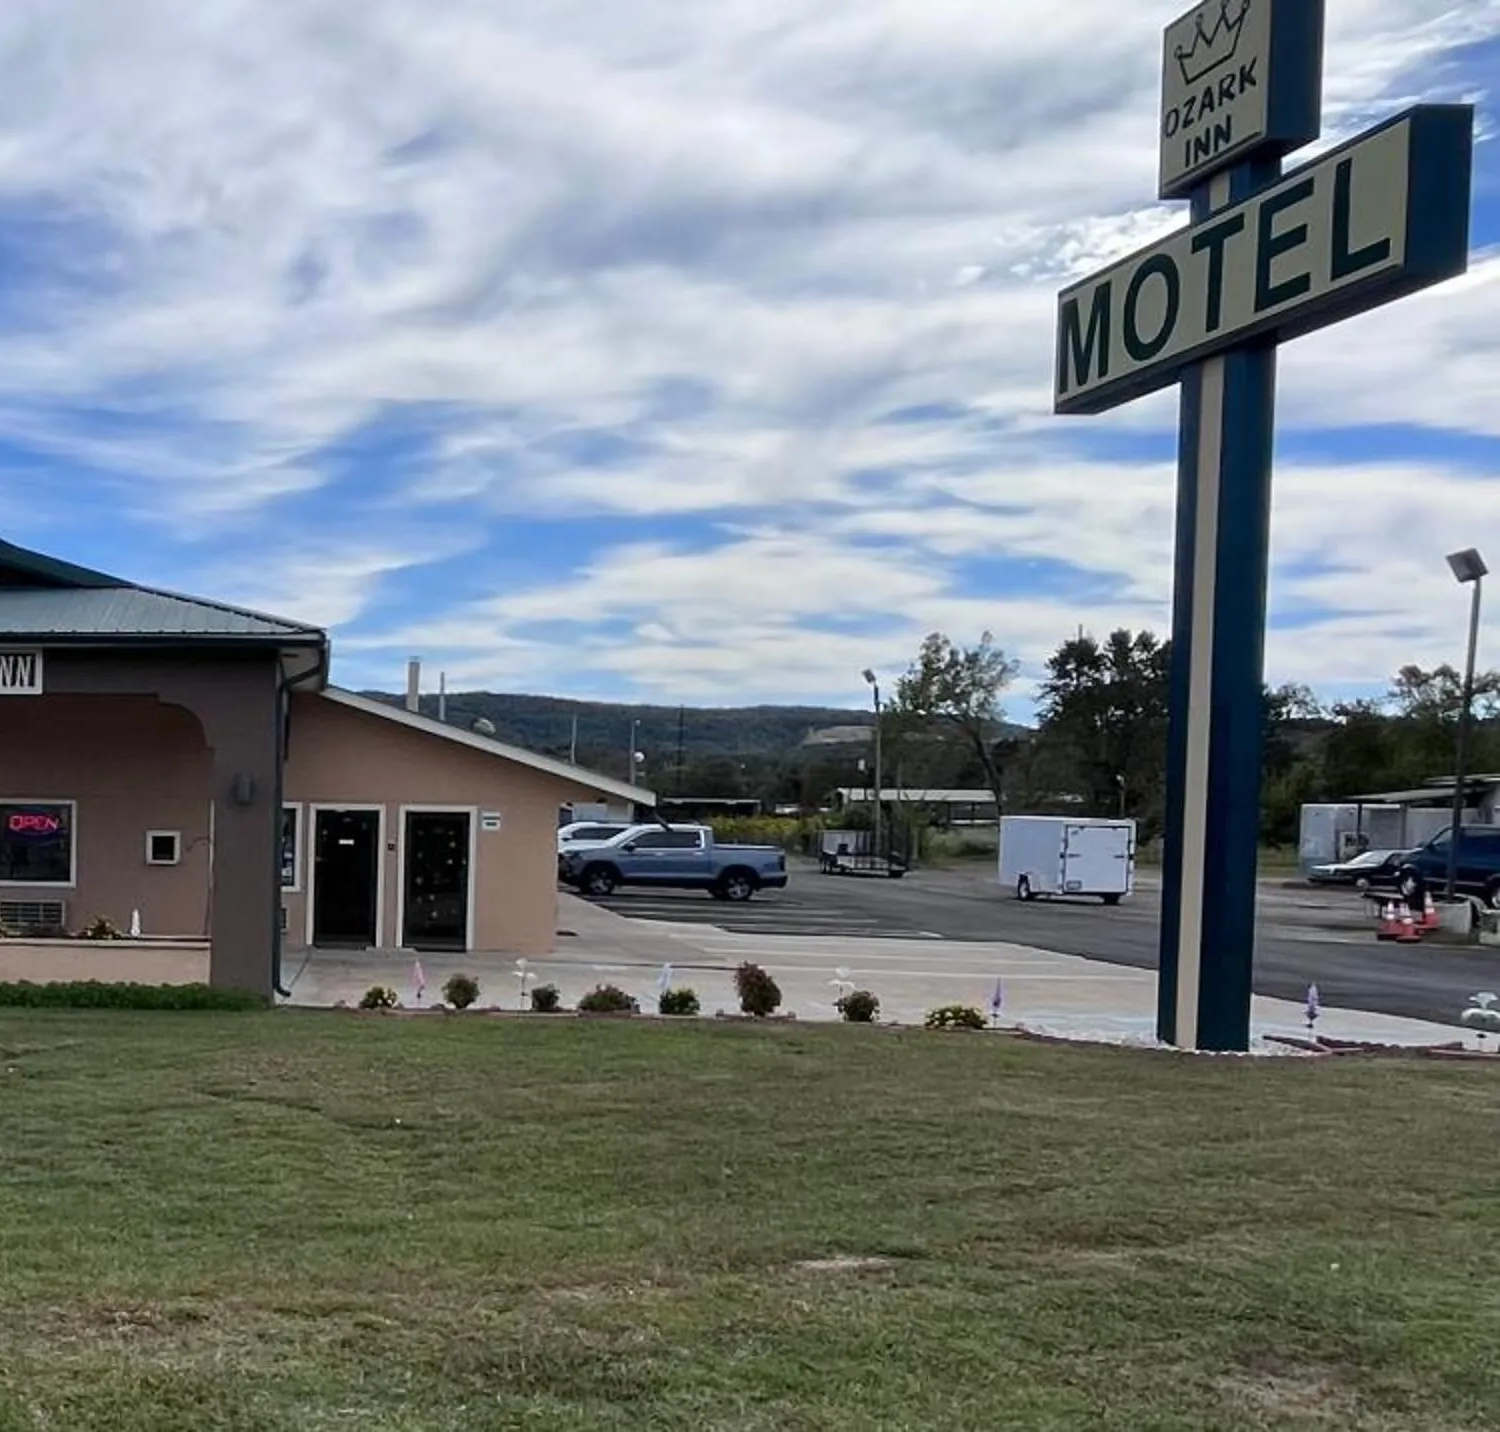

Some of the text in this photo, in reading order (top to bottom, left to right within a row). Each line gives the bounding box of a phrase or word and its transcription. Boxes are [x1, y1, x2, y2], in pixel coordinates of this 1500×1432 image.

[1165, 56, 1257, 138] OZARK
[1185, 114, 1232, 168] INN
[1058, 158, 1391, 394] MOTEL
[9, 815, 59, 830] OPEN
